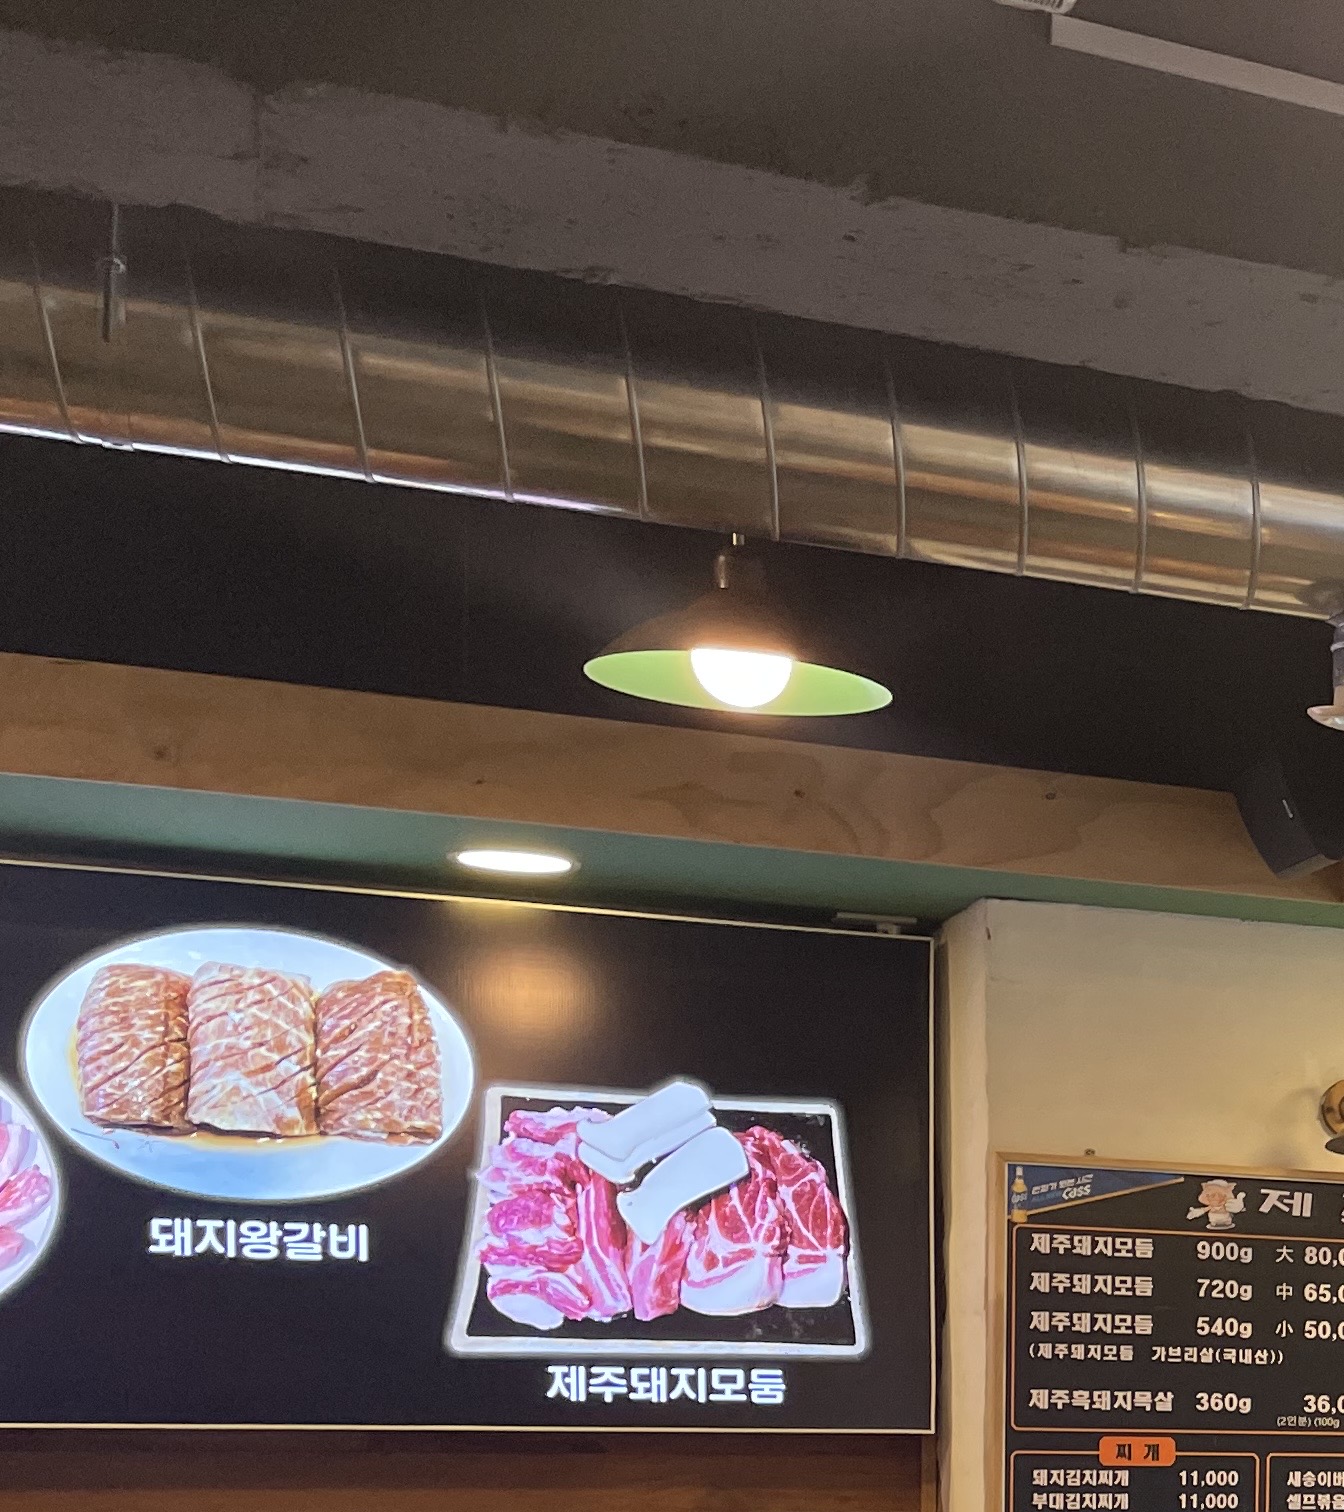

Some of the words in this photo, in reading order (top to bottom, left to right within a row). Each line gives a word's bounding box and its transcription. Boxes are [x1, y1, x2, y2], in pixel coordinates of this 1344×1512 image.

[148, 1217, 369, 1263] 돼지왕갈비
[1196, 1240, 1253, 1264] 900g
[1275, 1245, 1294, 1263] 大
[1196, 1278, 1253, 1301] 720g
[1276, 1282, 1293, 1301] 中
[1196, 1316, 1253, 1339] 540g
[1275, 1319, 1294, 1338] 小
[546, 1365, 787, 1404] 제주돼지모둠
[1195, 1392, 1252, 1414] 360g
[1179, 1470, 1239, 1487] 11,000
[1178, 1493, 1239, 1510] 11,000
